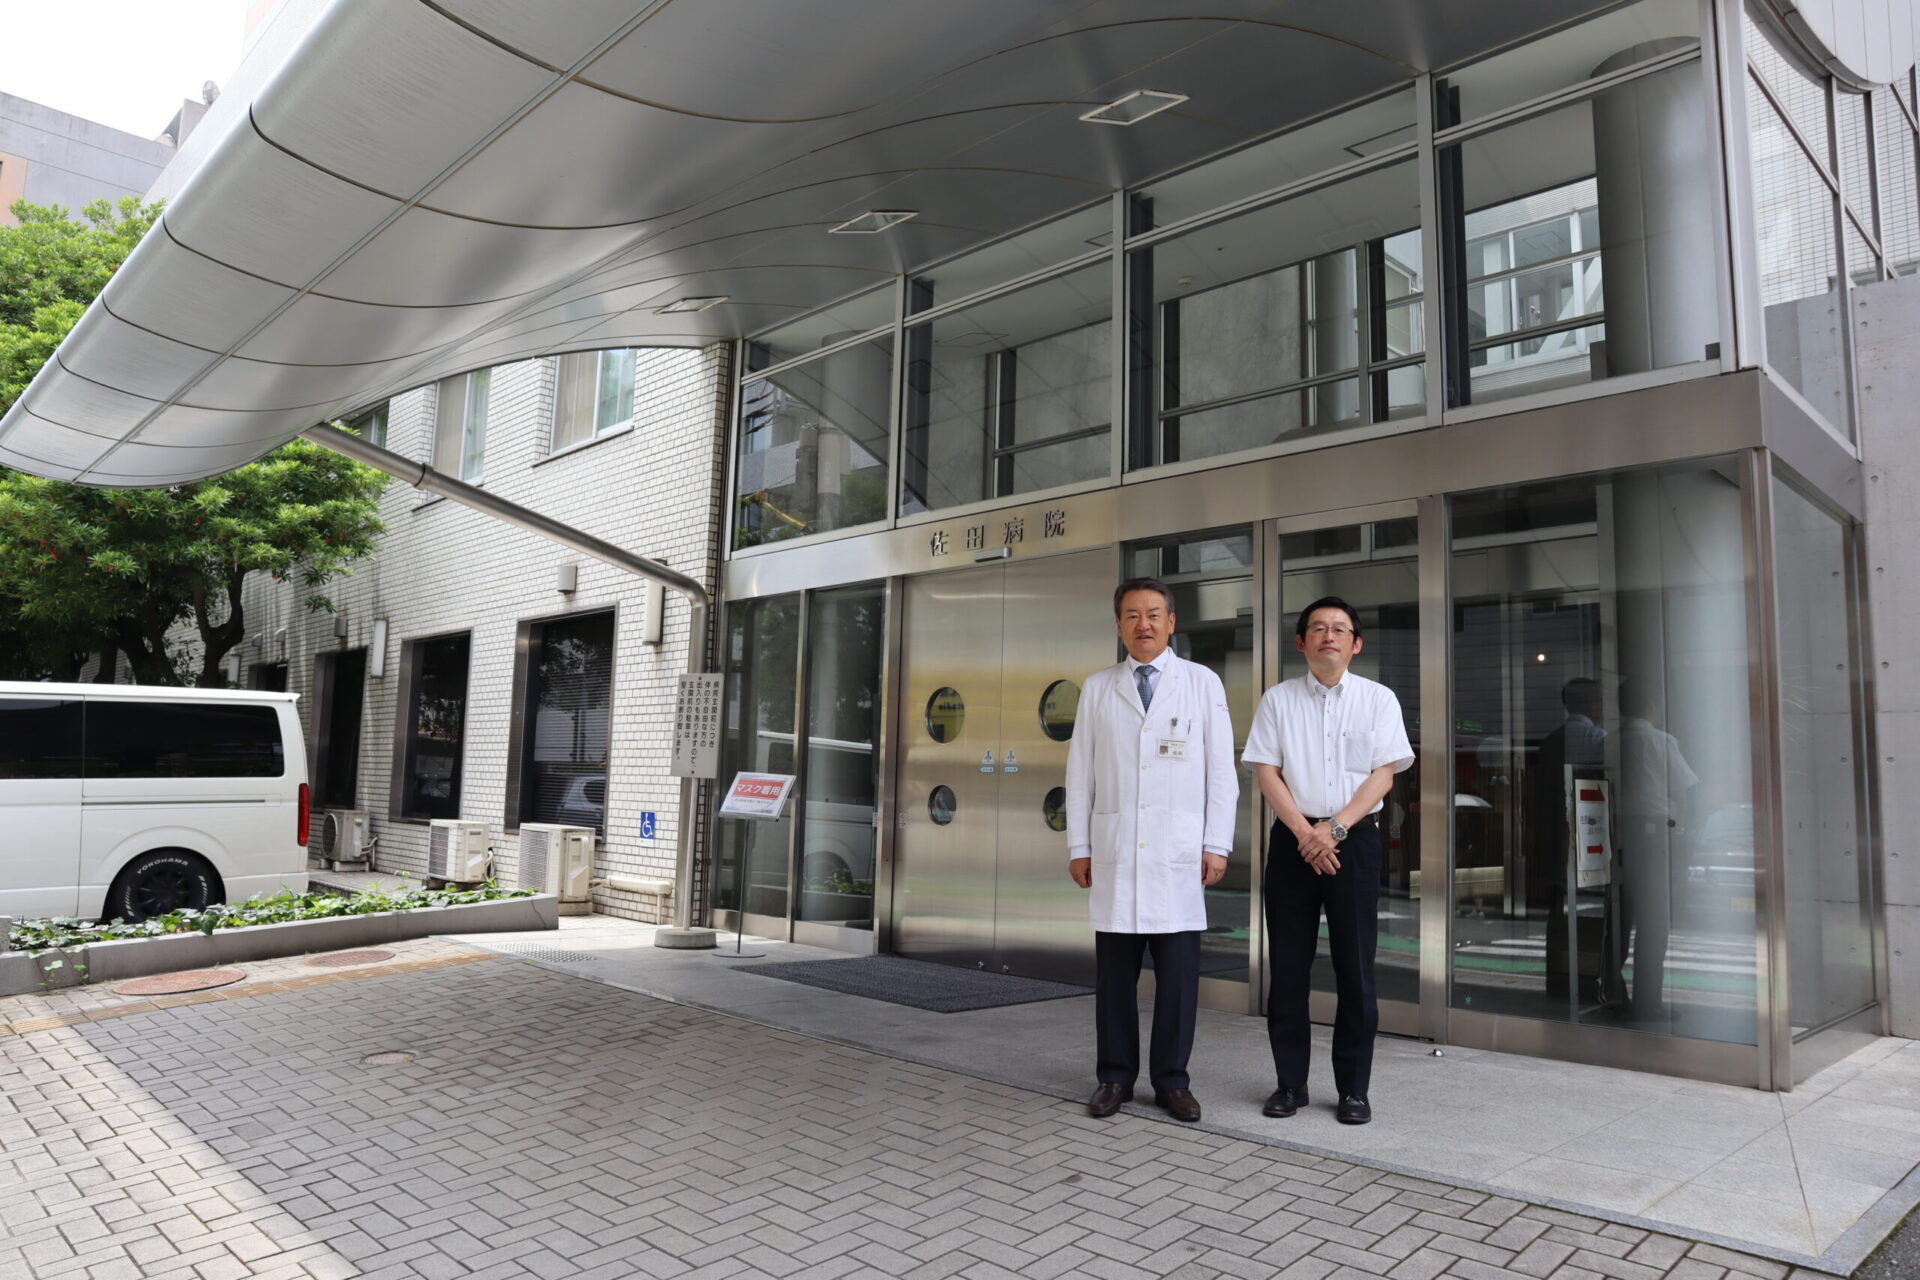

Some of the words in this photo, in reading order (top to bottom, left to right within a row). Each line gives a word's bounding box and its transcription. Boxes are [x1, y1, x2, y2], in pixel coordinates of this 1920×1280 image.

[930, 509, 1066, 557] 佐田病院
[700, 681, 711, 748] 体の不自由な方の
[709, 681, 719, 748] 病院玄関前につき
[736, 783, 782, 796] マスク着用
[137, 858, 188, 874] YOKOHAMA
